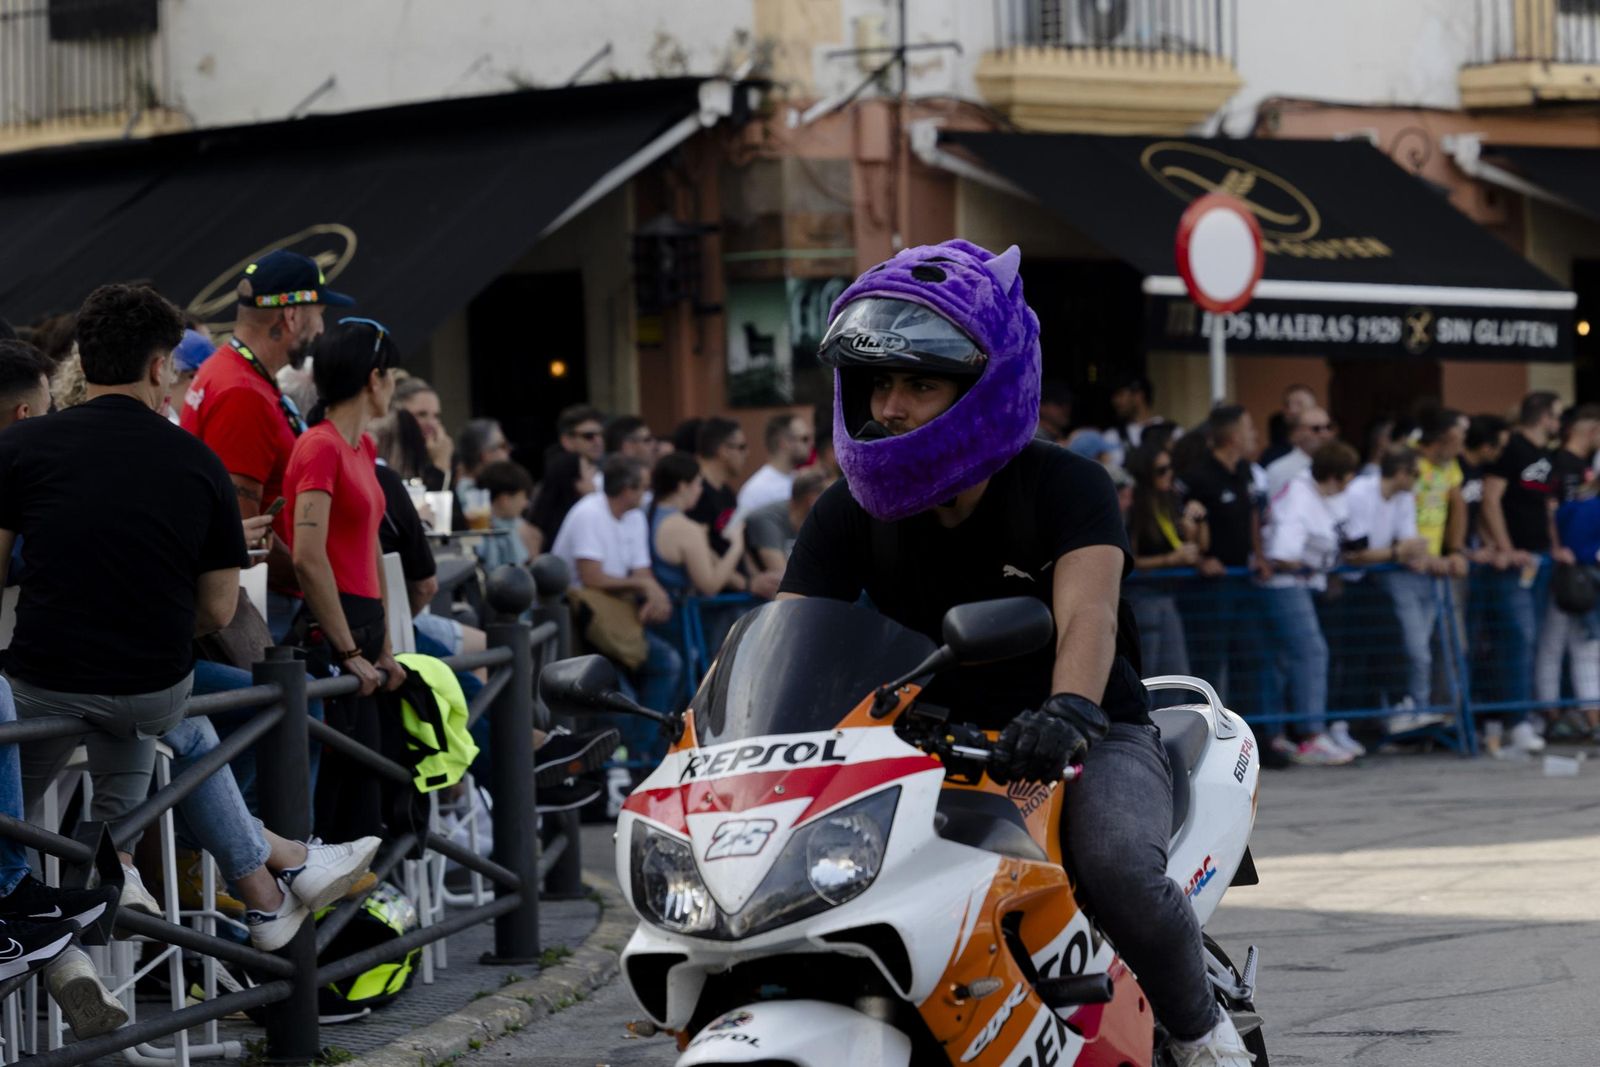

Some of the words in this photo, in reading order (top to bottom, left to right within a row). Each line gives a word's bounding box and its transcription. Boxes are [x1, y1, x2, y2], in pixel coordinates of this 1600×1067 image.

[1436, 316, 1473, 345] SIN
[1473, 317, 1559, 350] GLUTEN
[679, 738, 848, 784] REPSOL
[1018, 785, 1049, 818] HON
